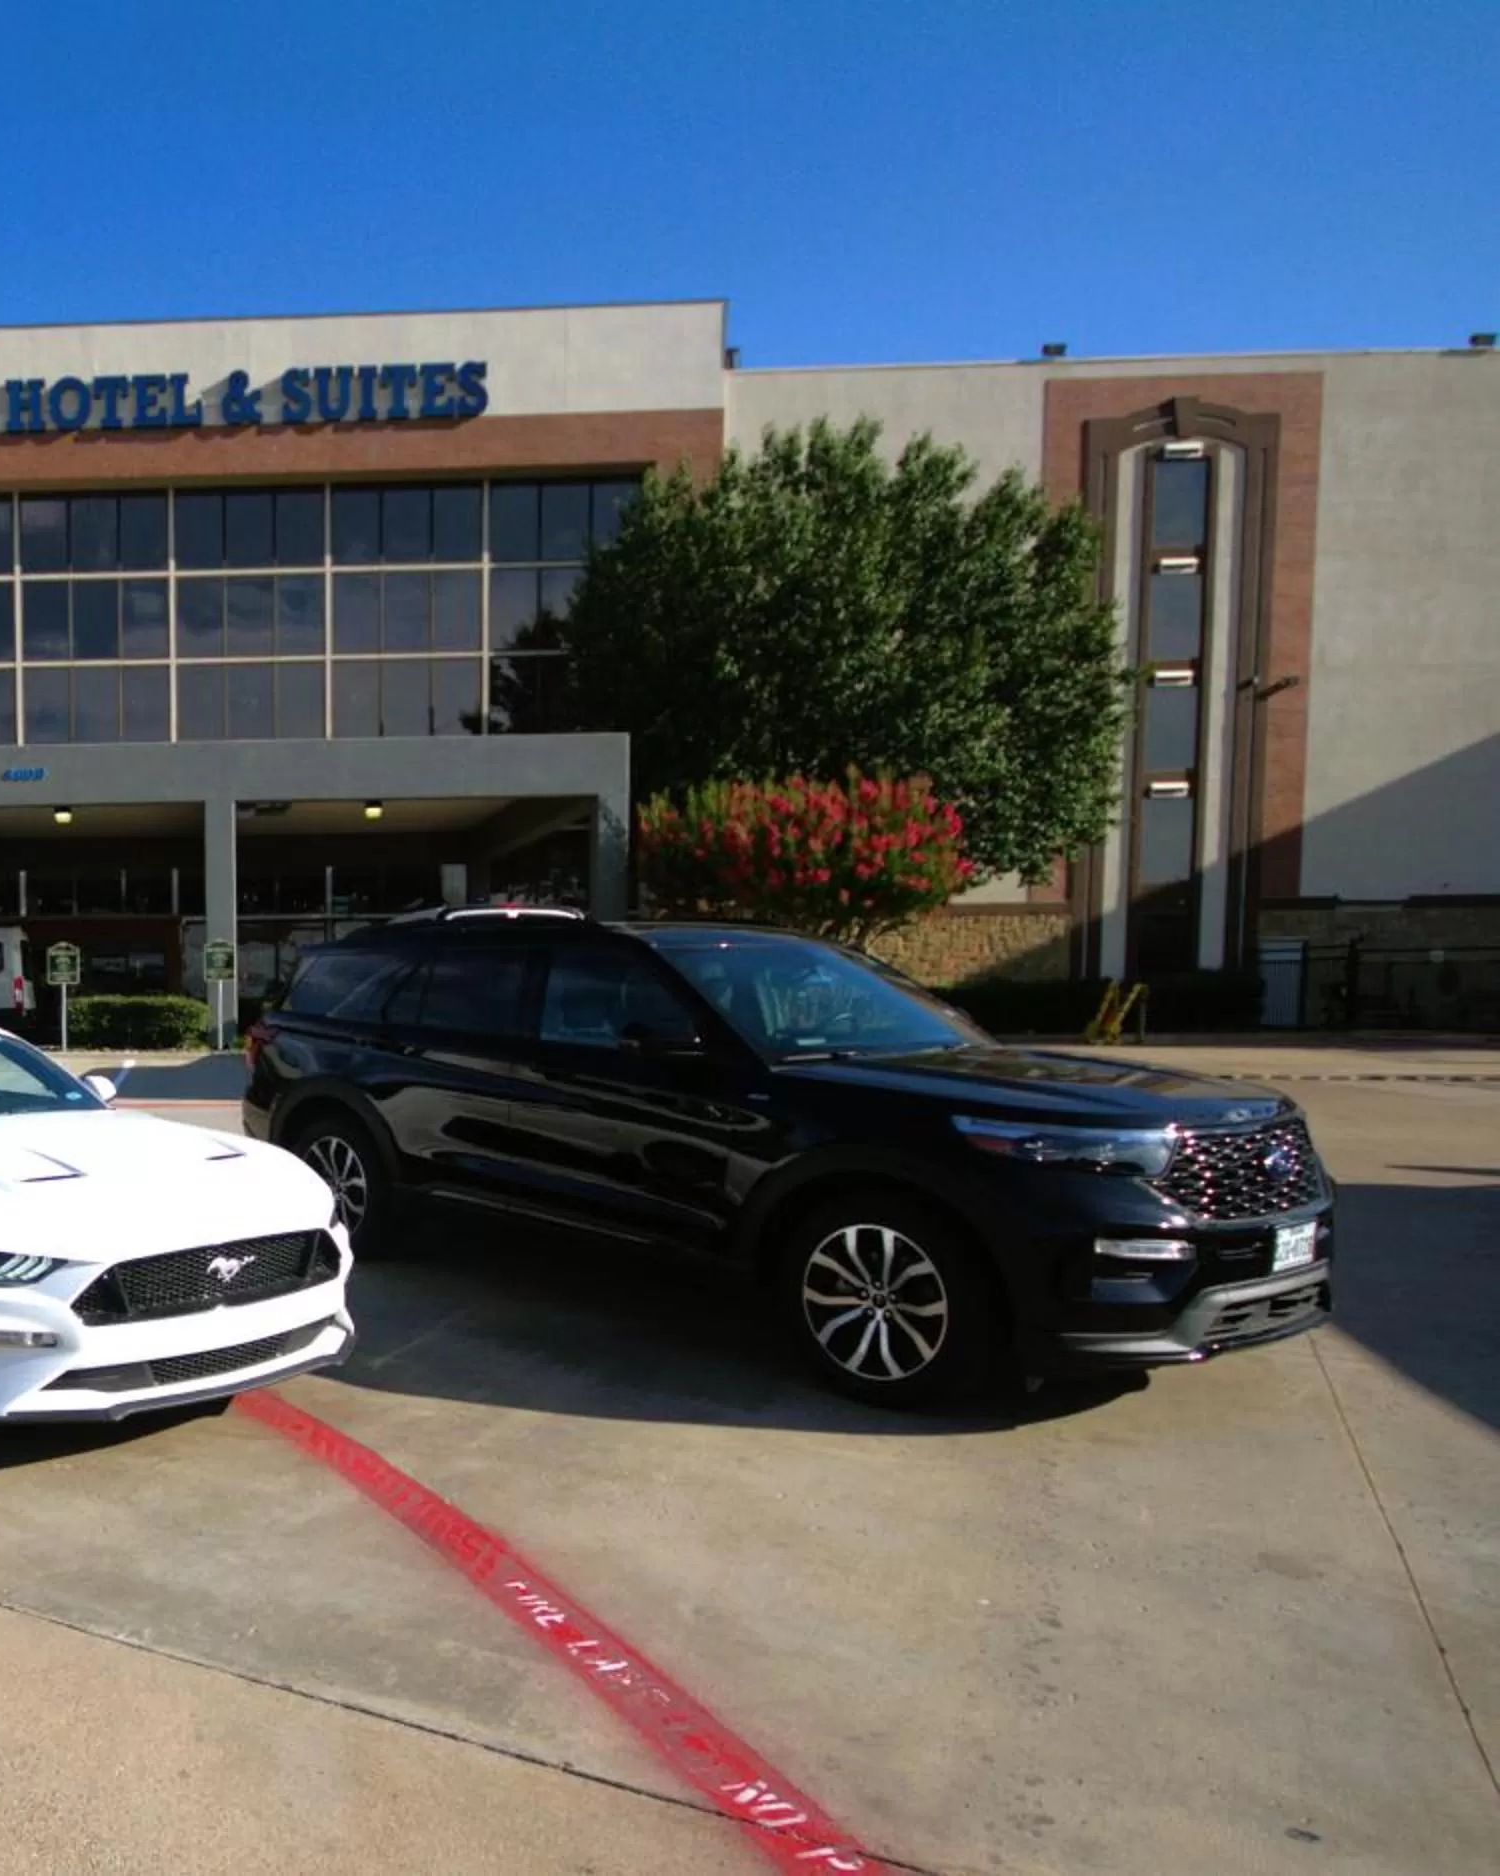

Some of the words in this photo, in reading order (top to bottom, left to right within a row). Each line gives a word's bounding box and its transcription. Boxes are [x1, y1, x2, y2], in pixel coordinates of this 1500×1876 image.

[5, 372, 202, 434] HOTEL
[222, 369, 262, 426] &
[281, 361, 489, 426] SUITES
[719, 1779, 807, 1828] NO
